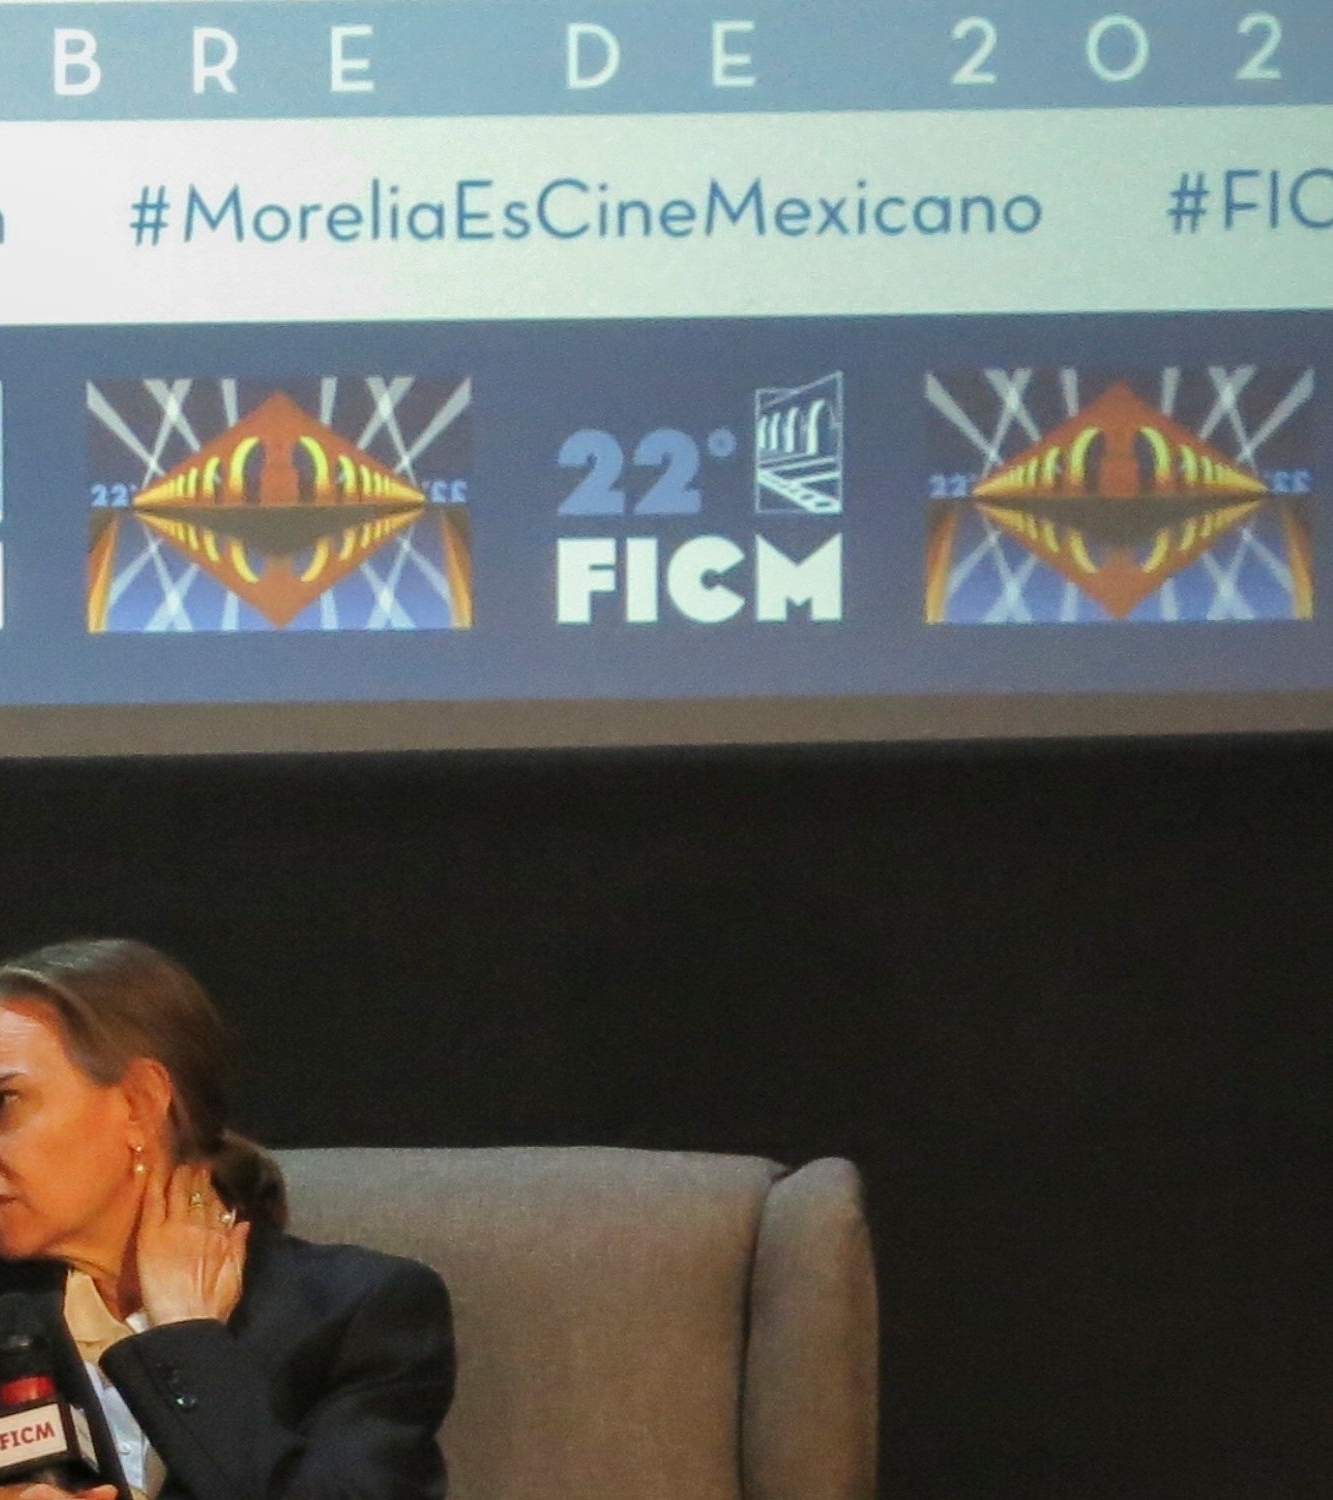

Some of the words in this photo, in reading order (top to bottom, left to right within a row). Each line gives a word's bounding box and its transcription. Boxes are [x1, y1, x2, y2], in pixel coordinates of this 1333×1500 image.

[566, 21, 756, 90] DE
[129, 177, 1043, 246] #MoreliaEsCineMexicano
[1167, 168, 1333, 233] #FIC
[557, 429, 736, 516] 22°
[557, 534, 842, 623] FICM
